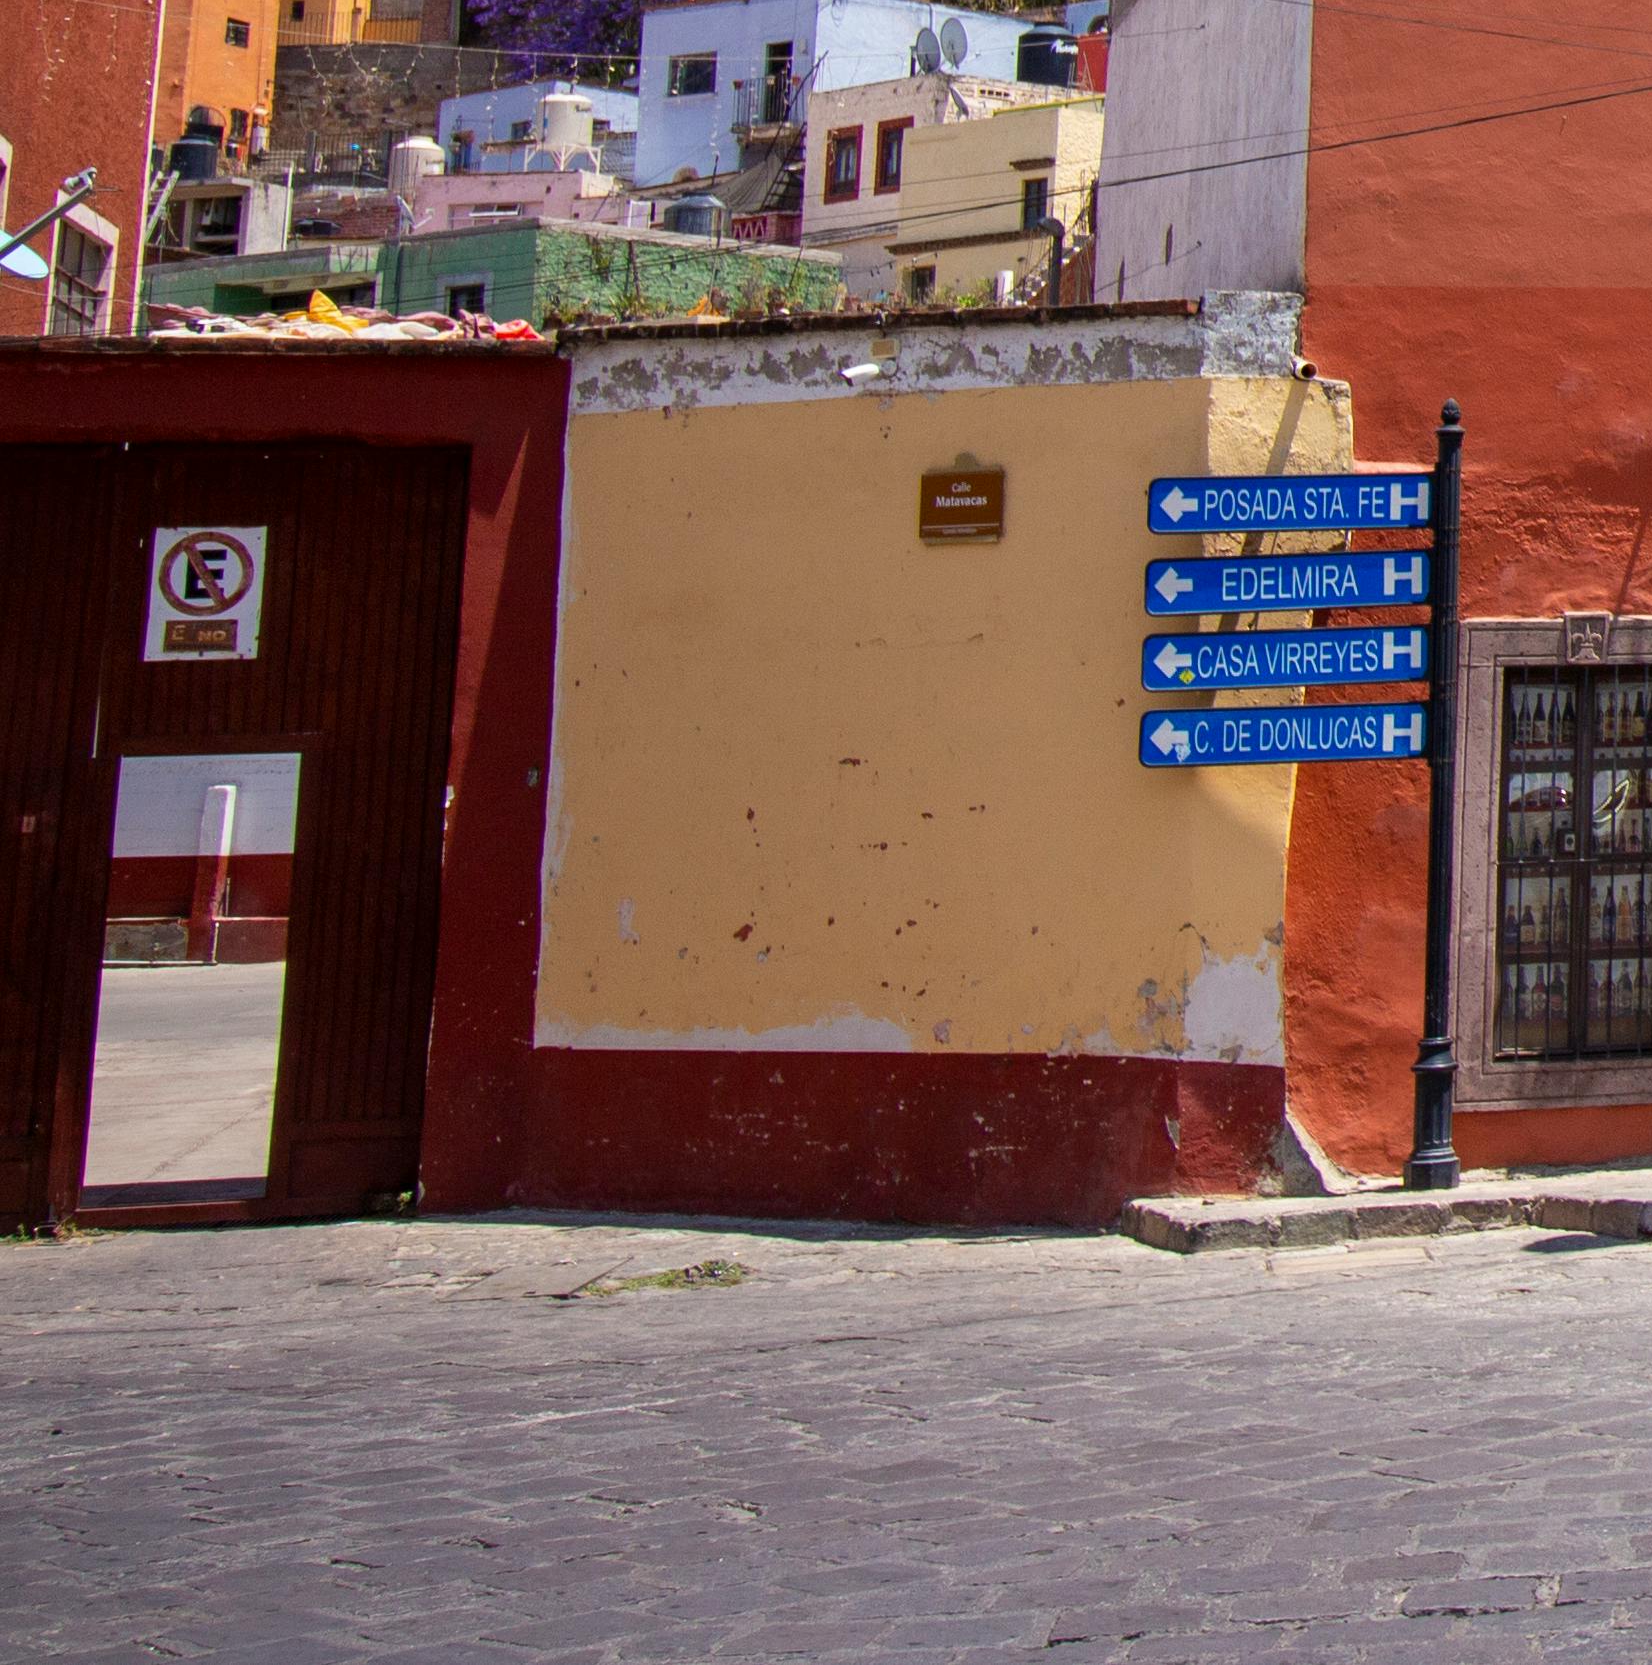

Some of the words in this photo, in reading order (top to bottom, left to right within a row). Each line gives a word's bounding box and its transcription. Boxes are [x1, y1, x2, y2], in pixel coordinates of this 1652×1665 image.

[935, 495, 988, 508] Matavacas
[951, 481, 972, 493] Calle
[1204, 488, 1297, 521] POSADA
[1303, 487, 1350, 519] STA.
[1358, 486, 1385, 518] FE
[1221, 564, 1359, 601] EDELMIRA
[1197, 645, 1260, 679] CASA
[1264, 639, 1379, 675] VIRREYES
[1194, 721, 1214, 754] C.
[1223, 719, 1252, 752] DE
[1259, 716, 1377, 751] DONLUCAS
